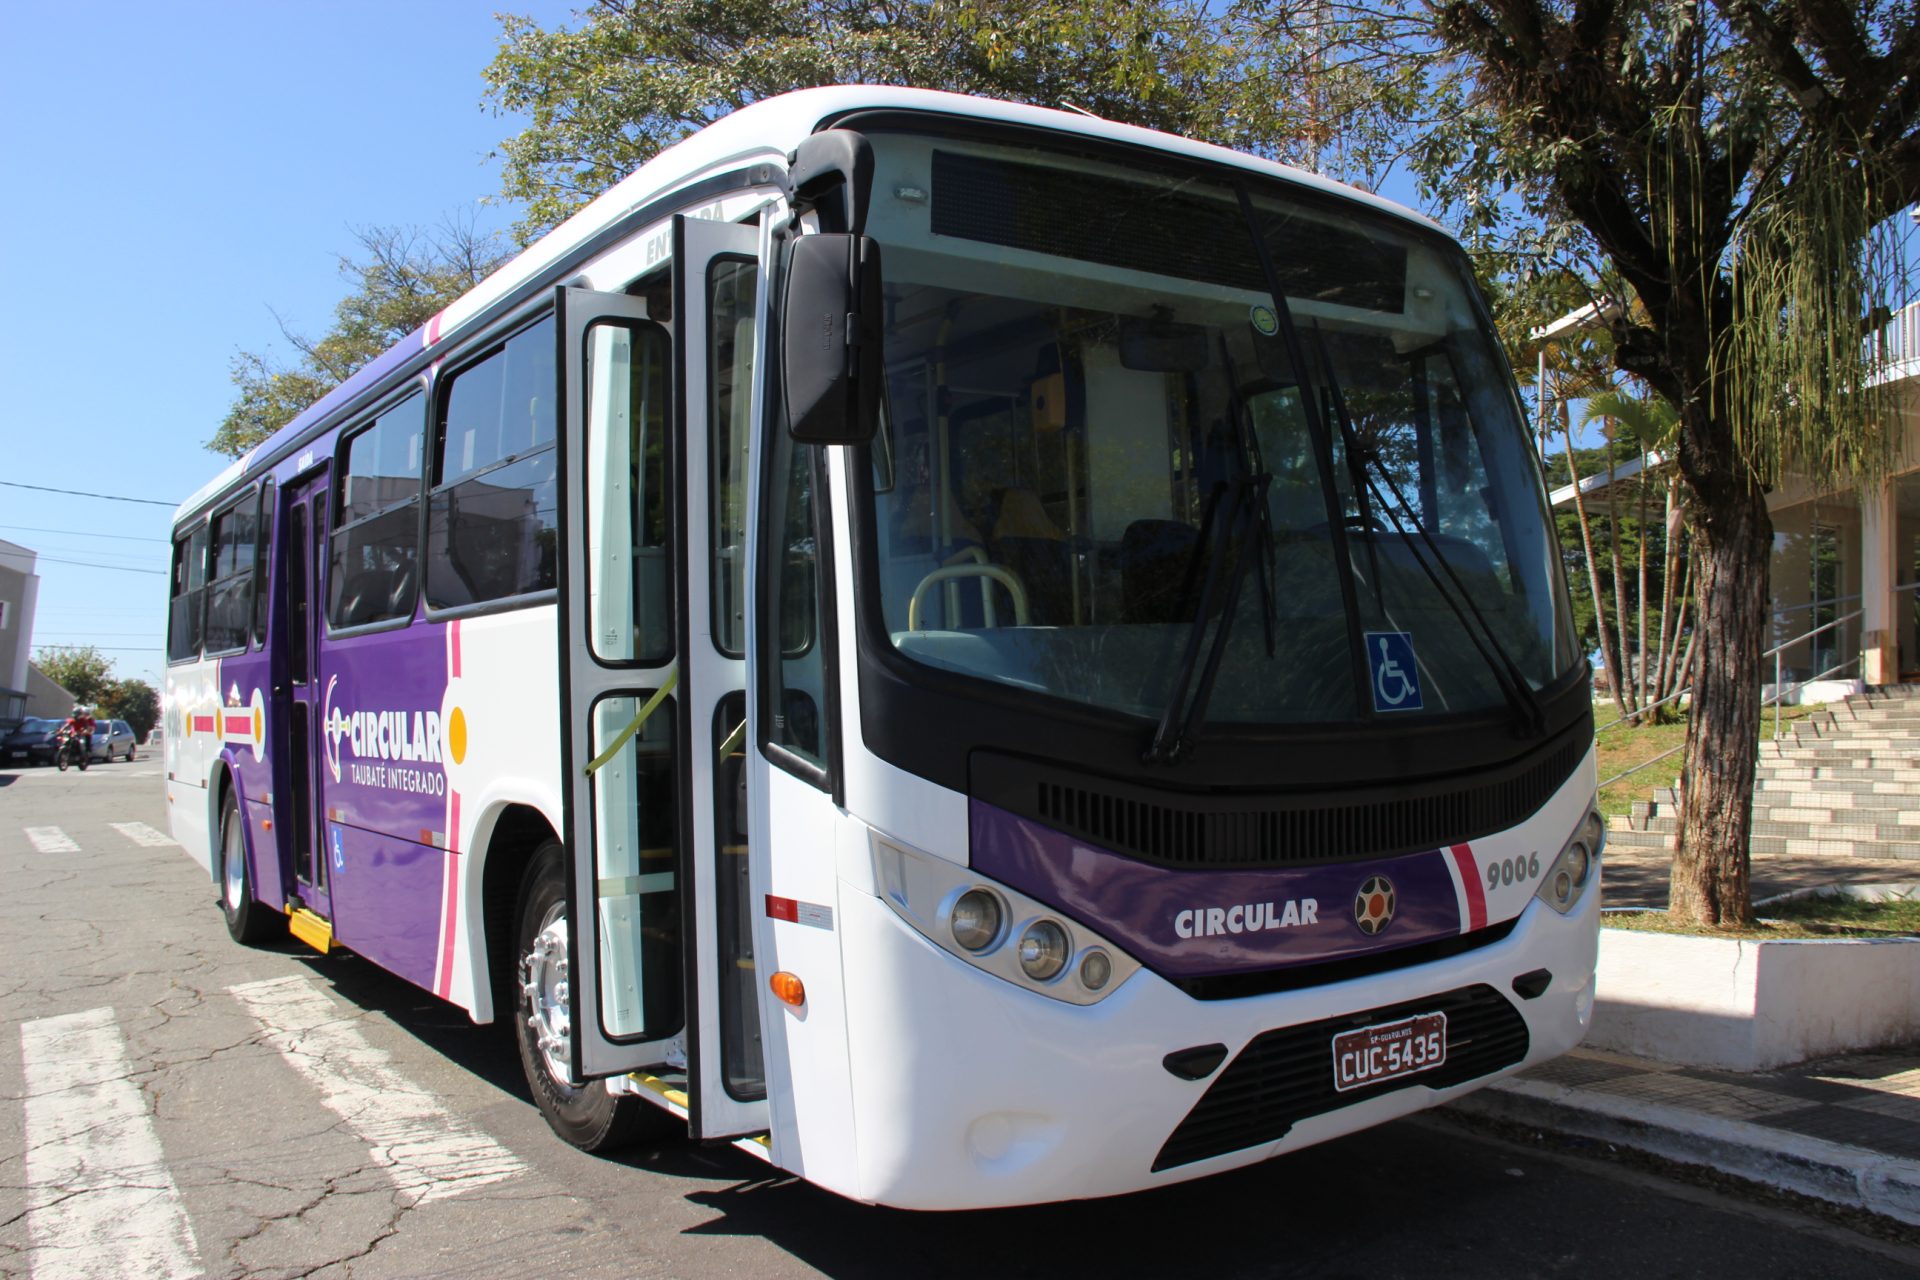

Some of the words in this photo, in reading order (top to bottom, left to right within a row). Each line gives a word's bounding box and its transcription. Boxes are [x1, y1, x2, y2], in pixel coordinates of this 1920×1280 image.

[351, 710, 442, 763] CIRCULAR
[351, 761, 386, 788] TAUBATÉ
[388, 767, 444, 797] INTEGRADO
[1487, 850, 1540, 891] 9006
[1174, 898, 1319, 939] CIRCULAR
